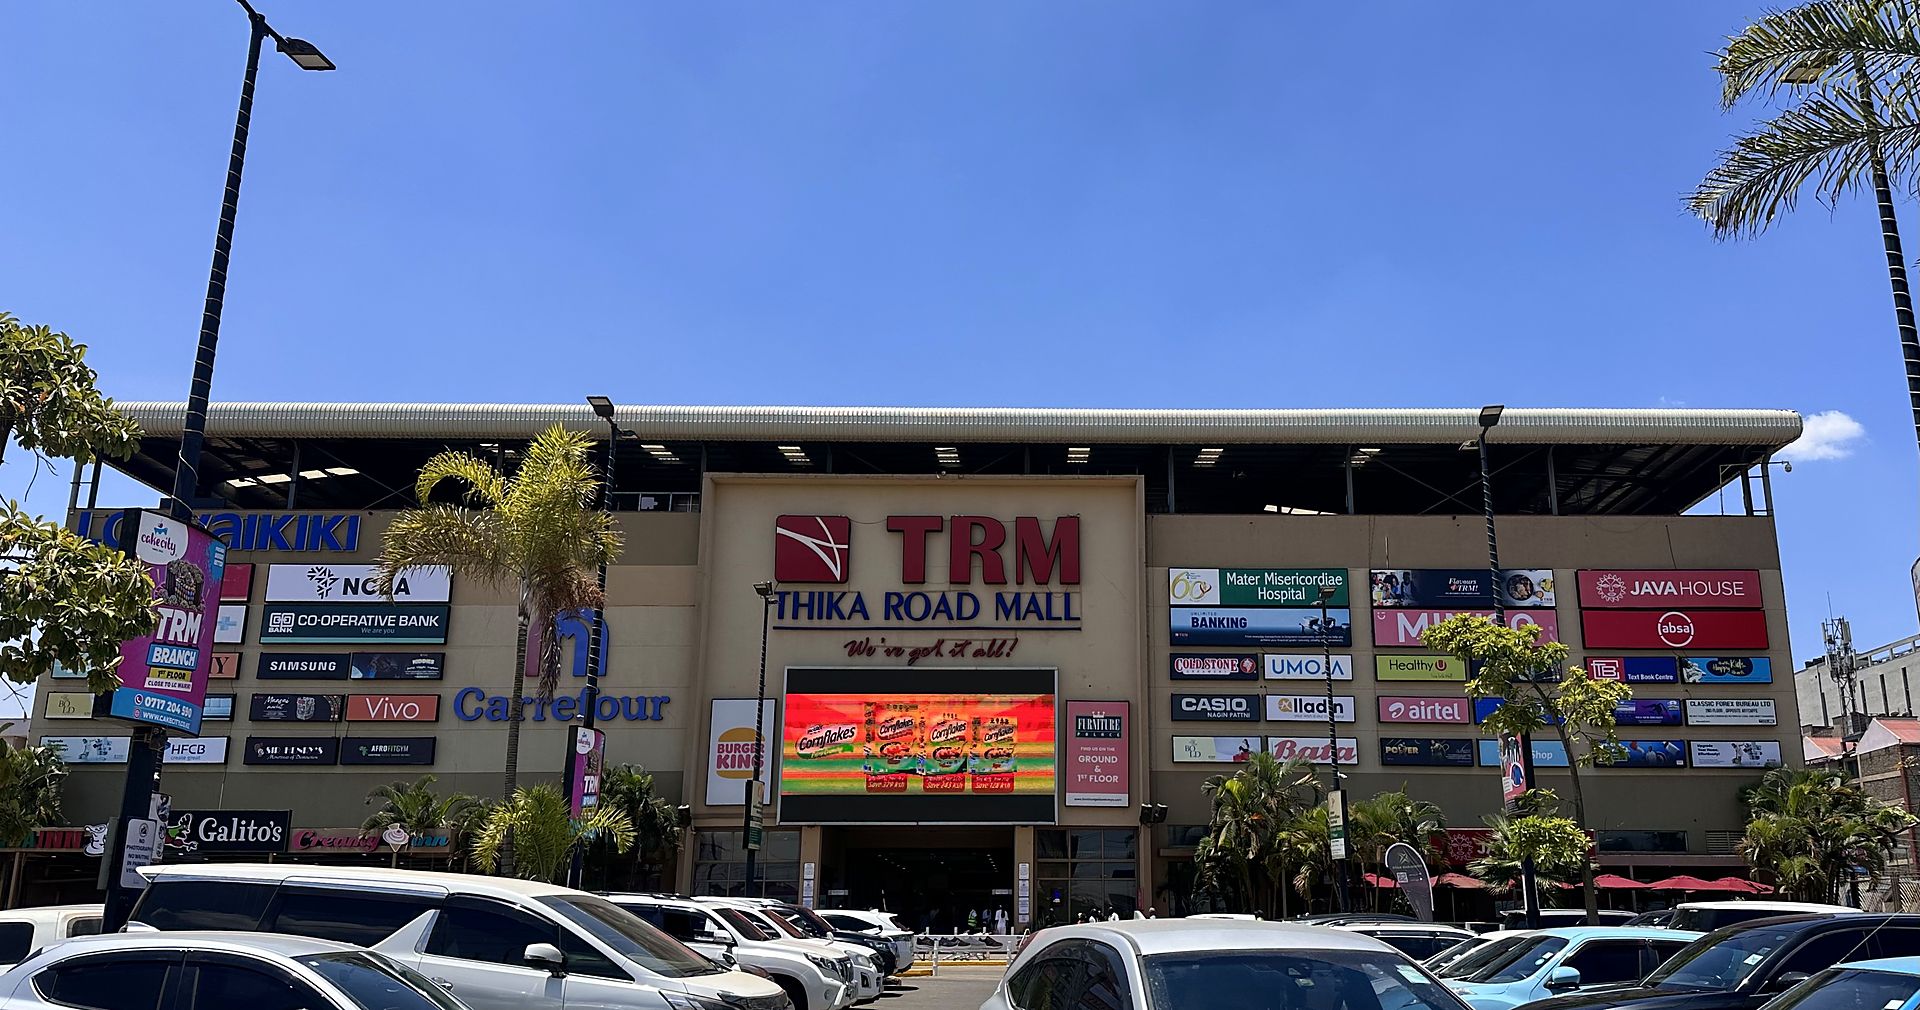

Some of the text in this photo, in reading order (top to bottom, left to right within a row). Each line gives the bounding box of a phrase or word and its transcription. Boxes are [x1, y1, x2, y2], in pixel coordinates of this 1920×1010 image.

[887, 516, 1081, 586] TRM
[342, 577, 411, 596] NCA
[1227, 573, 1343, 586] Mater Misericordiae
[1258, 588, 1306, 604] Hospital
[1630, 581, 1745, 596] JAVA HOUSE
[776, 591, 1081, 621] THIKA ROAD MALL
[156, 607, 203, 645] TRM
[399, 615, 440, 627] BANK
[1191, 616, 1248, 628] BANKING
[1661, 621, 1690, 634] absa
[152, 647, 197, 667] BRANCH
[845, 636, 1018, 665] We've got it all!
[270, 661, 337, 671] SAMSUNG
[1175, 657, 1239, 673] COLD STONE
[167, 671, 187, 680] FLOOR
[1628, 673, 1674, 681] Text Book Centre
[145, 697, 166, 710] 0717
[167, 701, 181, 714] 204
[366, 697, 420, 719] Vivo
[1181, 697, 1247, 712] CASIO
[1409, 701, 1460, 720] airtel
[880, 719, 914, 735] Cornflakes
[932, 721, 966, 740] Cornflakes
[1078, 718, 1120, 731] FURNITURE
[799, 727, 856, 751] Cornflakes
[171, 744, 206, 755] HFCB
[1274, 739, 1356, 761] Bata
[1078, 755, 1118, 763] GROUND
[1094, 765, 1102, 773] &
[1078, 774, 1119, 783] 1ST FLOOR
[199, 816, 283, 843] Galito's
[37, 830, 83, 849] INN
[293, 830, 379, 852] Creamy
